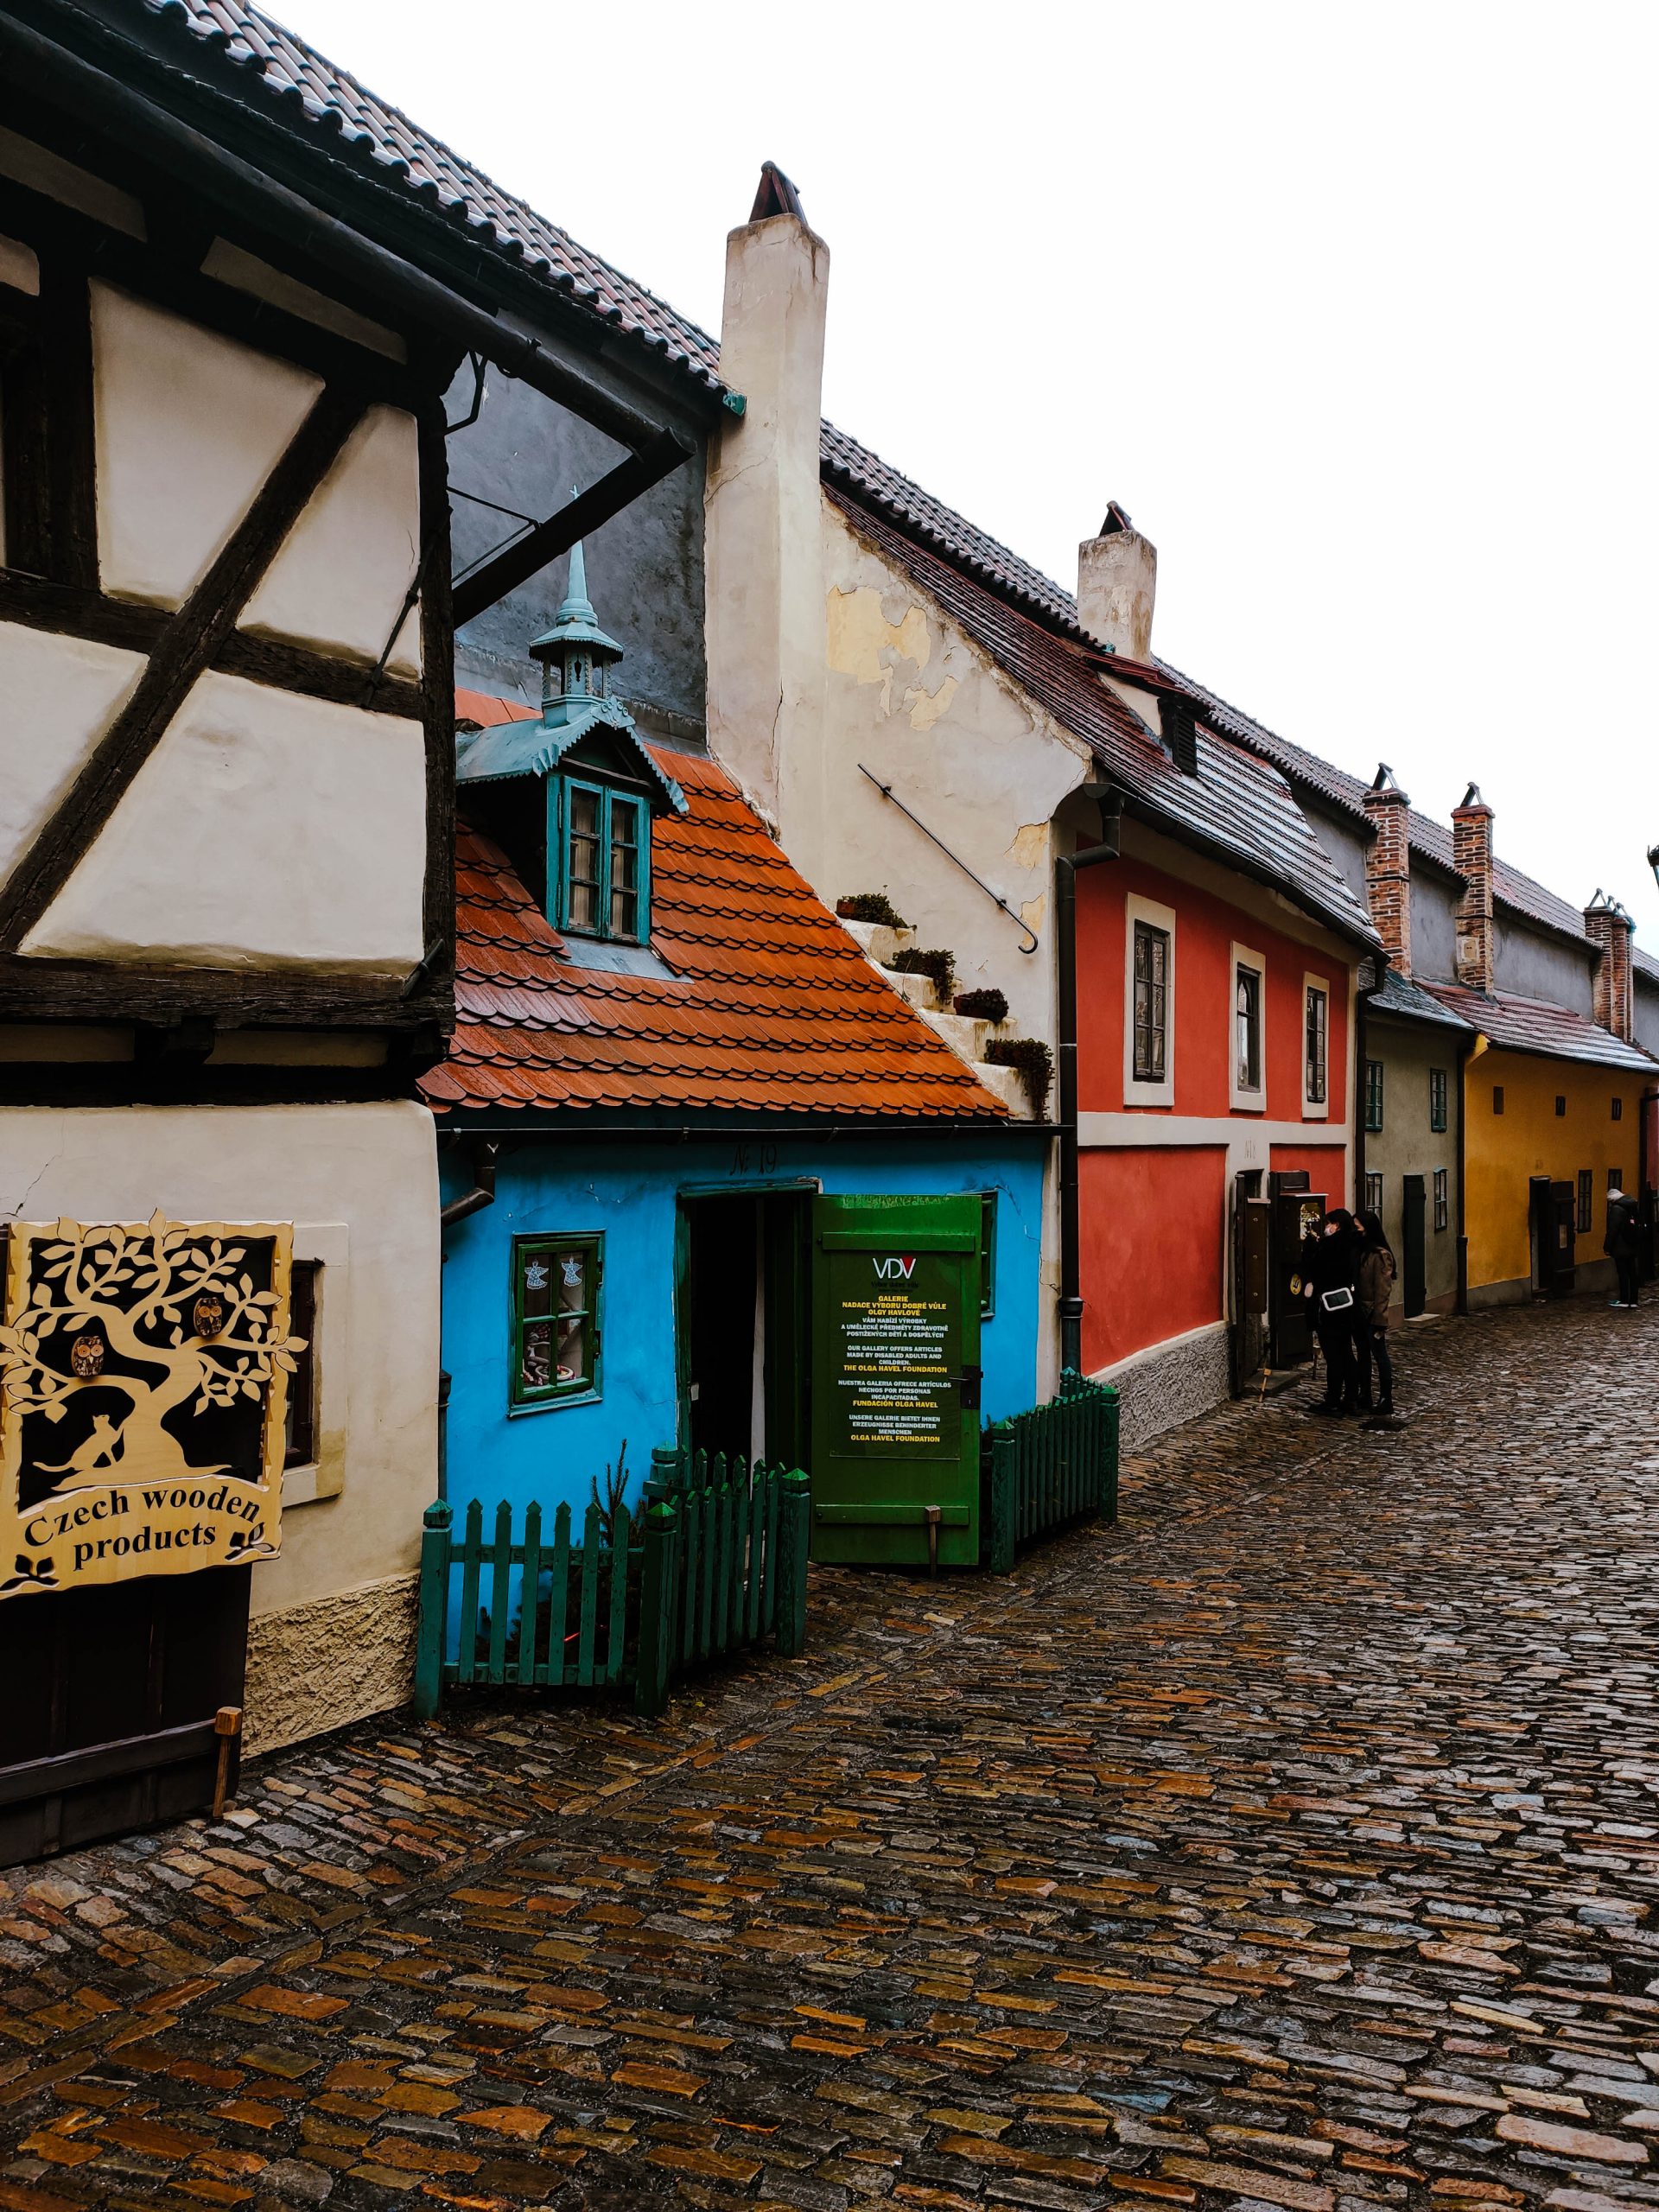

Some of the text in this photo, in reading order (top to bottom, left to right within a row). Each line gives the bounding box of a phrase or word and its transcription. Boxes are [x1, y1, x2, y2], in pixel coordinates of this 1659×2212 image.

[758, 1144, 777, 1175] 19
[873, 1257, 917, 1279] VDV
[928, 1301, 946, 1310] VŮLE
[24, 1486, 262, 1547] Czech wooden
[73, 1522, 216, 1572] products
